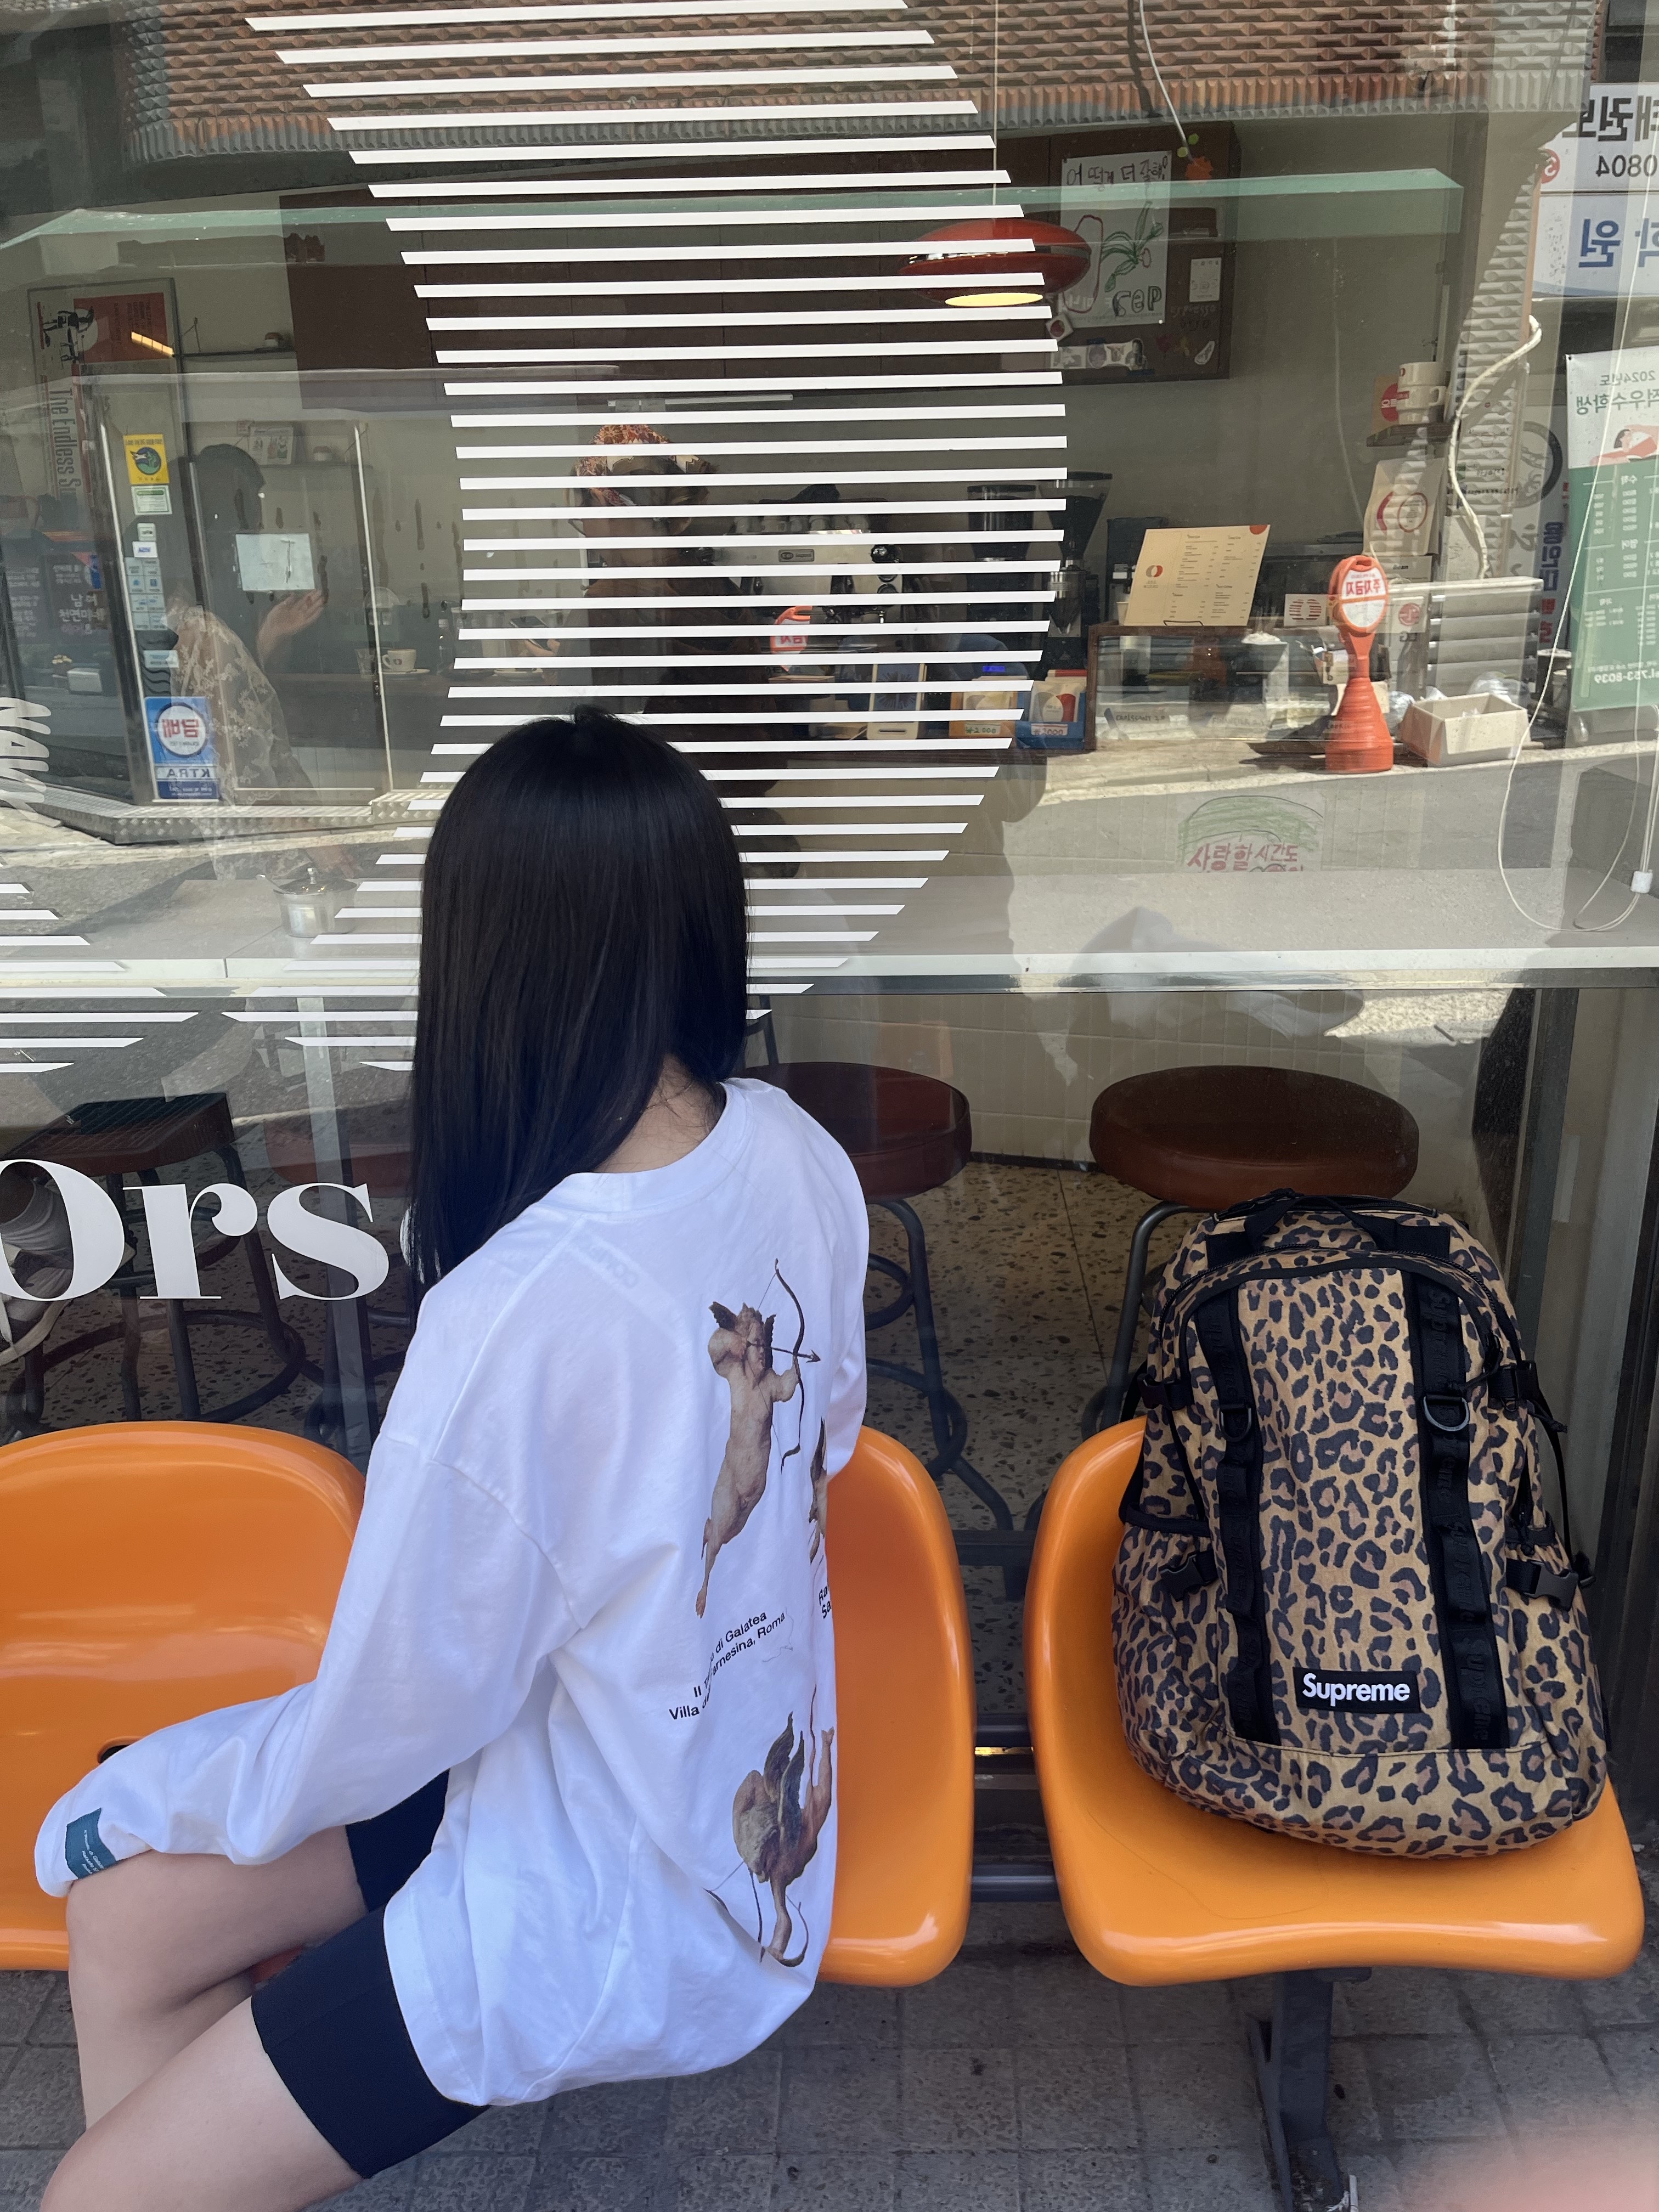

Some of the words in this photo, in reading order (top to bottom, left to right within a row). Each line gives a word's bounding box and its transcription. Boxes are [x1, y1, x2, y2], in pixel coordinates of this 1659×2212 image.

[49, 388, 72, 414] The
[52, 418, 77, 474] Endless
[1187, 843, 1252, 871] 사랑할
[1254, 843, 1299, 862] 시간도
[819, 1585, 828, 1606] Ra
[822, 1600, 832, 1619] Sa
[669, 1705, 700, 1720] Villa
[711, 1637, 755, 1675] arnesina,
[758, 1612, 785, 1639] Roma
[693, 1685, 702, 1697] Il
[715, 1638, 724, 1654] di
[725, 1612, 767, 1643] Galatea
[1302, 1673, 1410, 1707] Supreme
